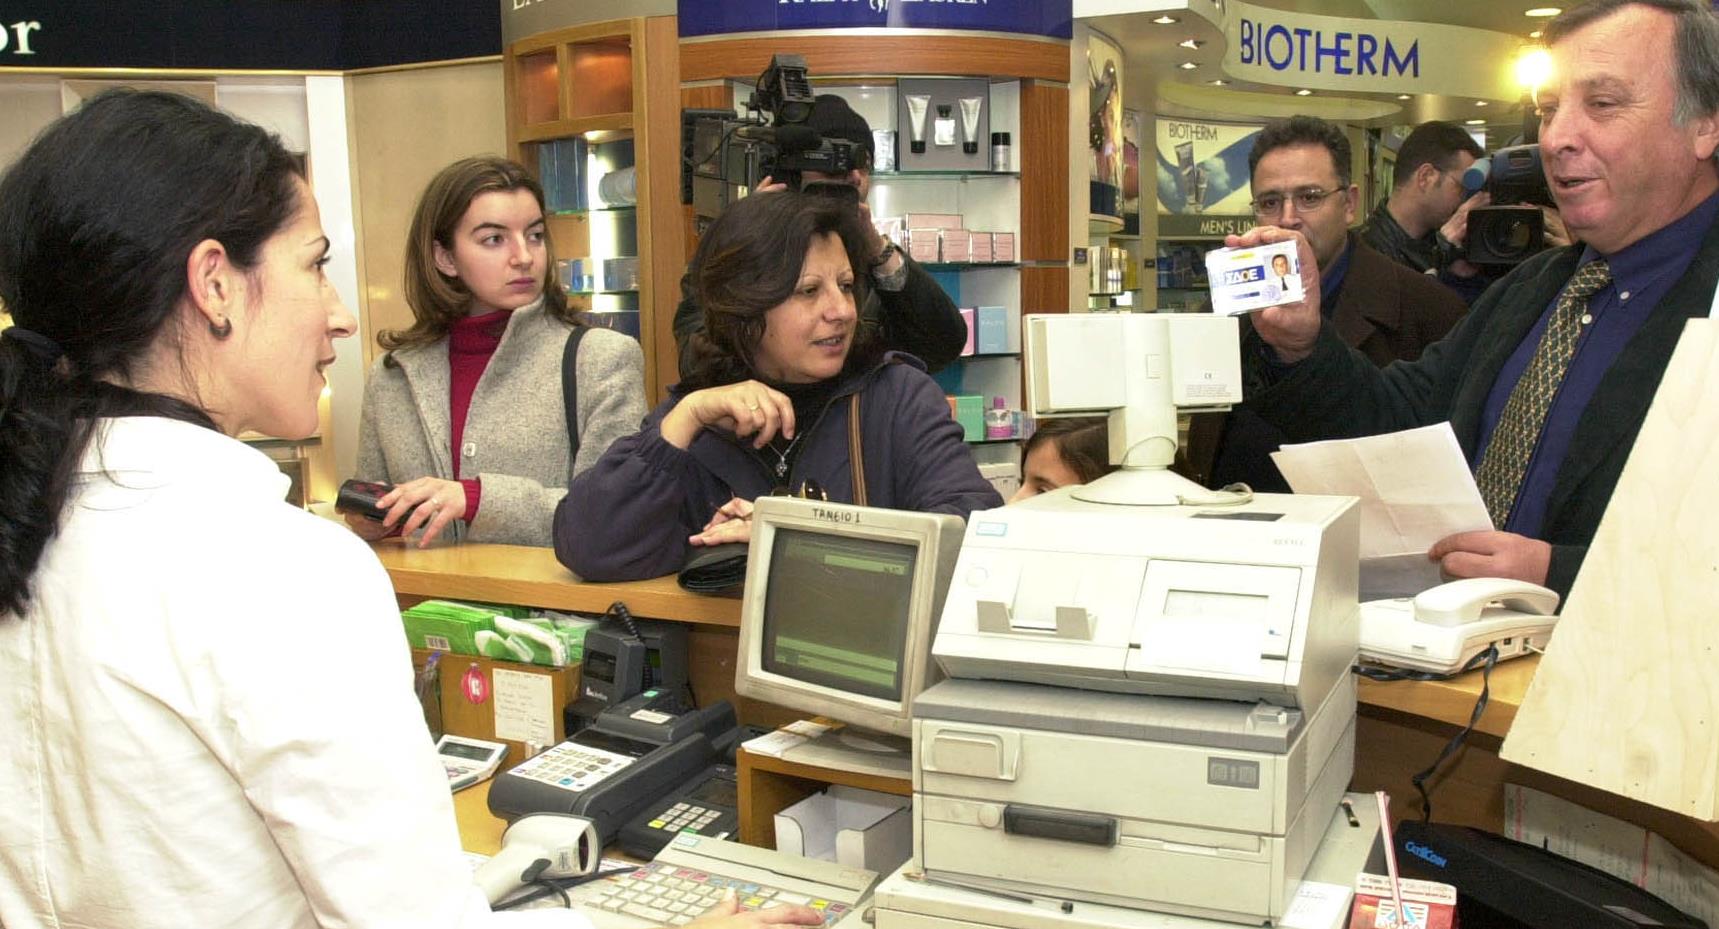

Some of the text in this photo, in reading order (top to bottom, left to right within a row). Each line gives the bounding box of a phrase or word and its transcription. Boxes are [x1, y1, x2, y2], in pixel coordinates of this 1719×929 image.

[1240, 19, 1419, 78] BIOTHERM
[1168, 122, 1218, 141] BIOTHERM
[1200, 219, 1258, 235] MEN'S LIN
